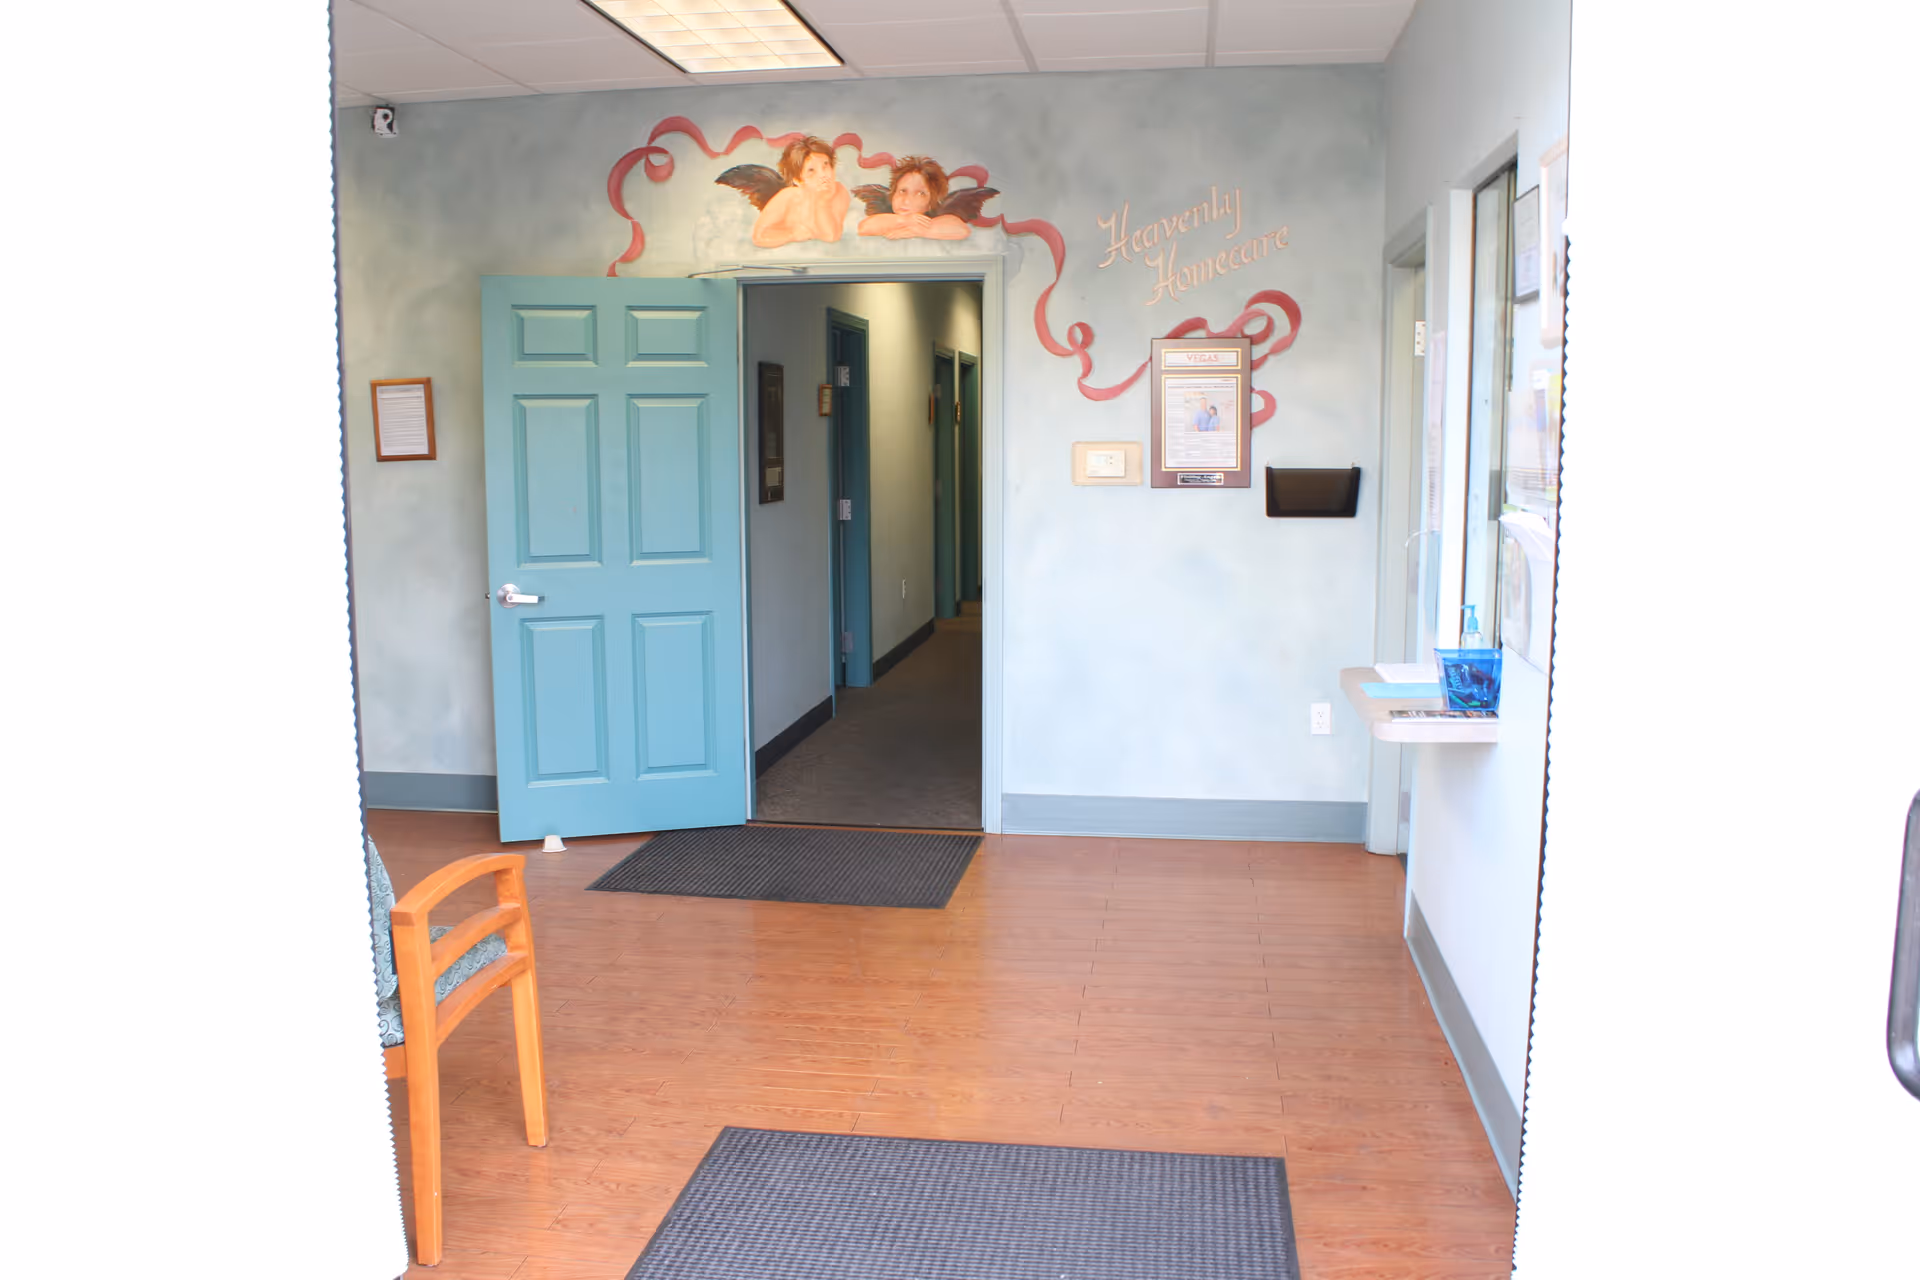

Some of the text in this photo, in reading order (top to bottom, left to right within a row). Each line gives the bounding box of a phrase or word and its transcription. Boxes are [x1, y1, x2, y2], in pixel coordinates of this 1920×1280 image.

[1097, 185, 1242, 268] Heavenly
[1144, 225, 1289, 305] Homecare
[1186, 353, 1218, 363] VEGAS
